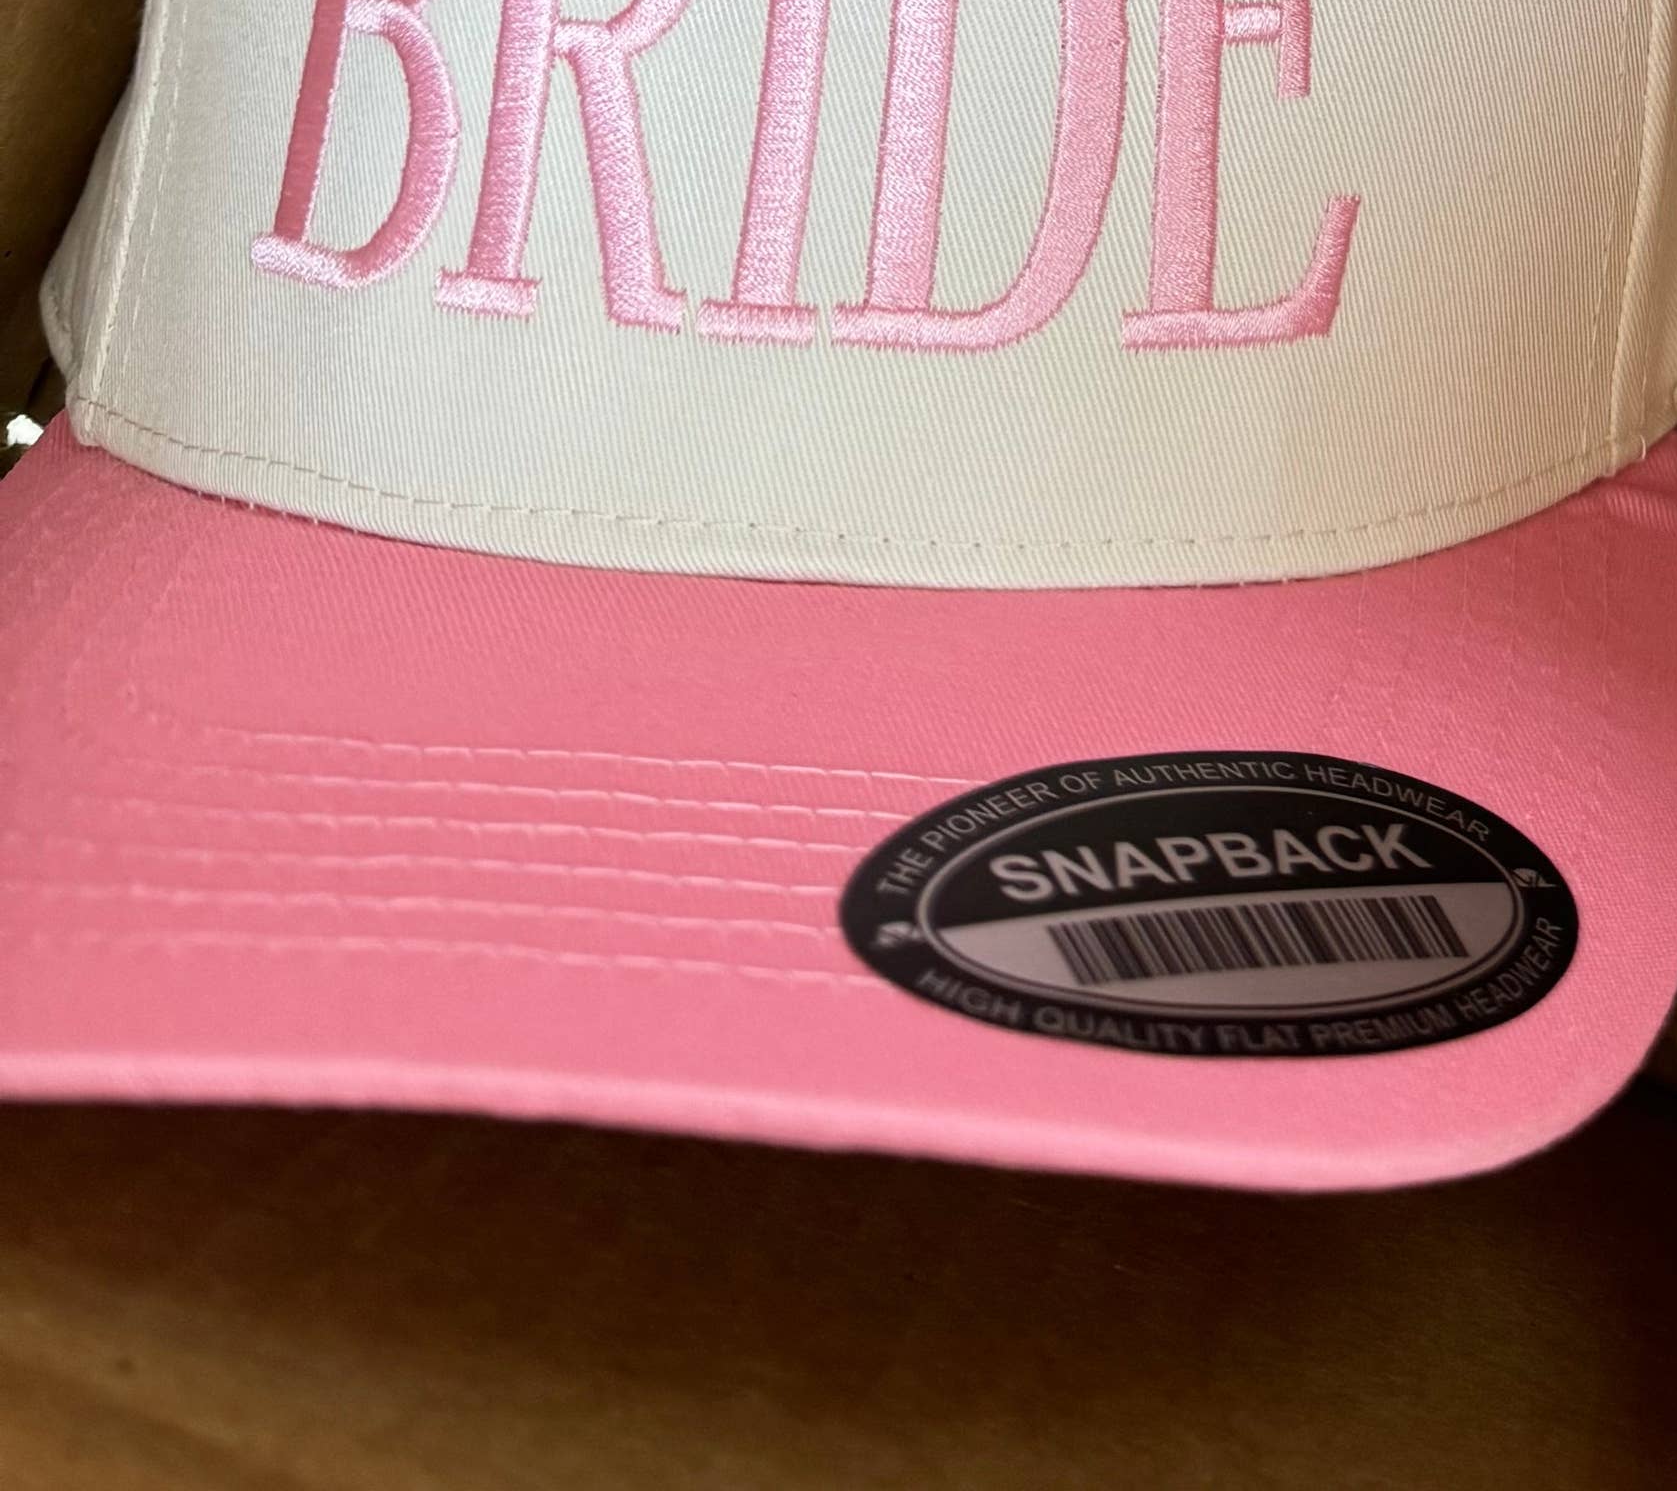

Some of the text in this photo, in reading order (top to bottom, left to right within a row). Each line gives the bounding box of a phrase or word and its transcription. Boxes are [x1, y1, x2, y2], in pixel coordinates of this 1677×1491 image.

[875, 760, 1491, 898] THE PIONEER OF AUTHENTIC HEADWEAR
[987, 822, 1433, 904] SNAPBACK
[913, 916, 1564, 1052] HIGH QUALITY FLAT PREMIUM HEADWEAR
